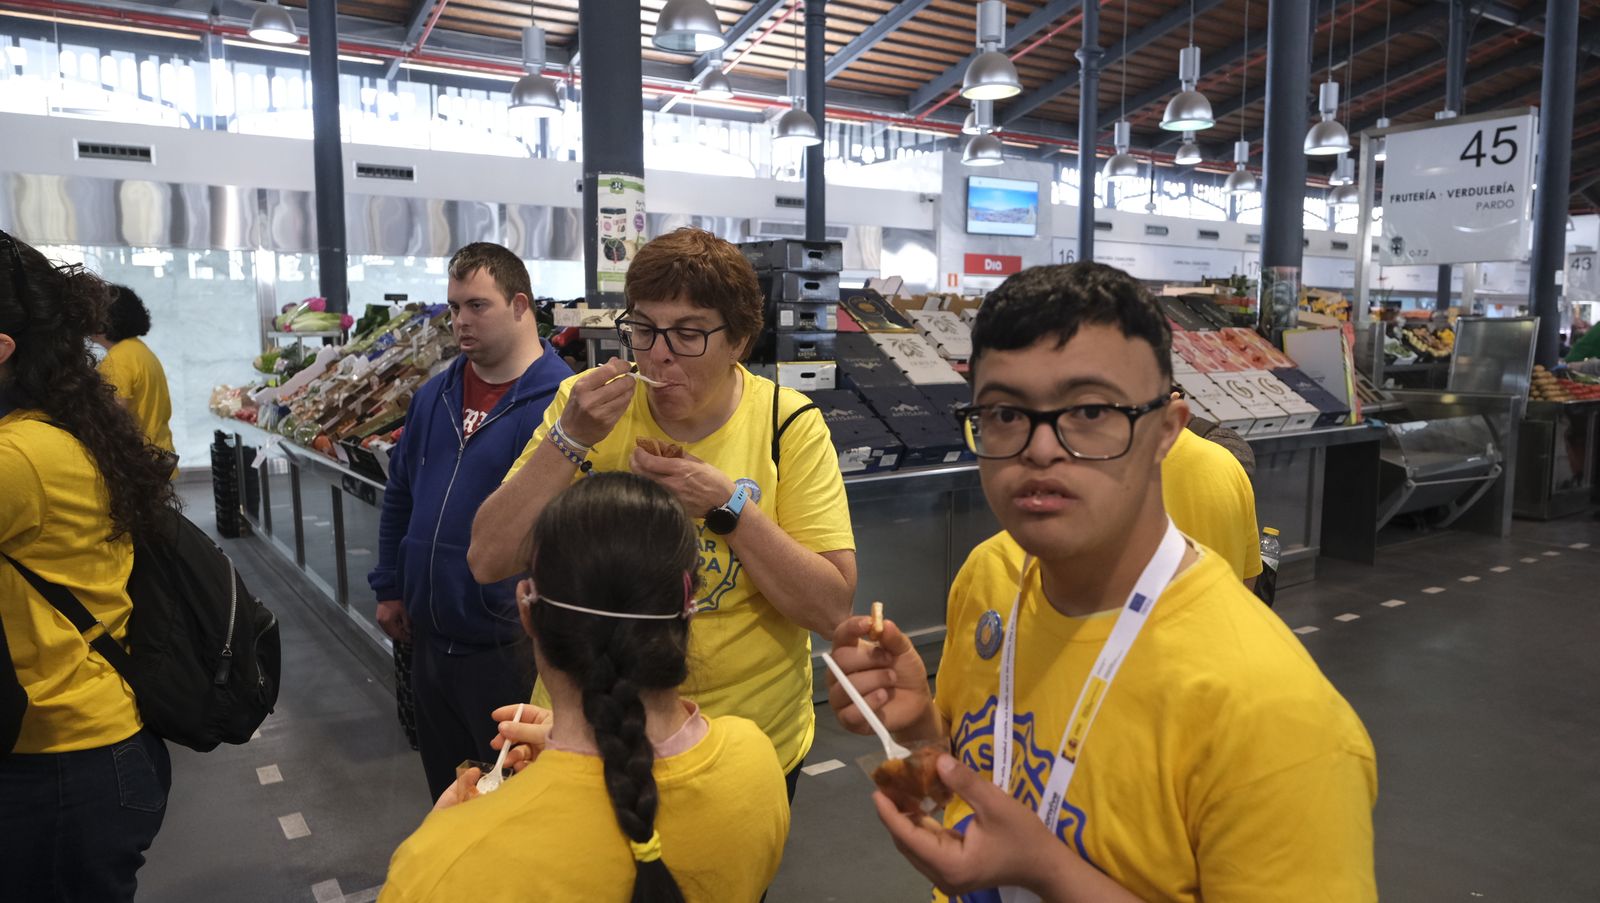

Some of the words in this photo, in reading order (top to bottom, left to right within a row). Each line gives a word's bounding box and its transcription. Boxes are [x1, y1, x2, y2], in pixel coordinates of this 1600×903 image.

[1460, 125, 1518, 168] 45
[1390, 189, 1436, 204] FRUTERÍA
[1447, 181, 1515, 199] VERDULERÍA
[1475, 199, 1515, 211] PARDO
[1059, 249, 1075, 265] 16
[1570, 257, 1592, 271] 43
